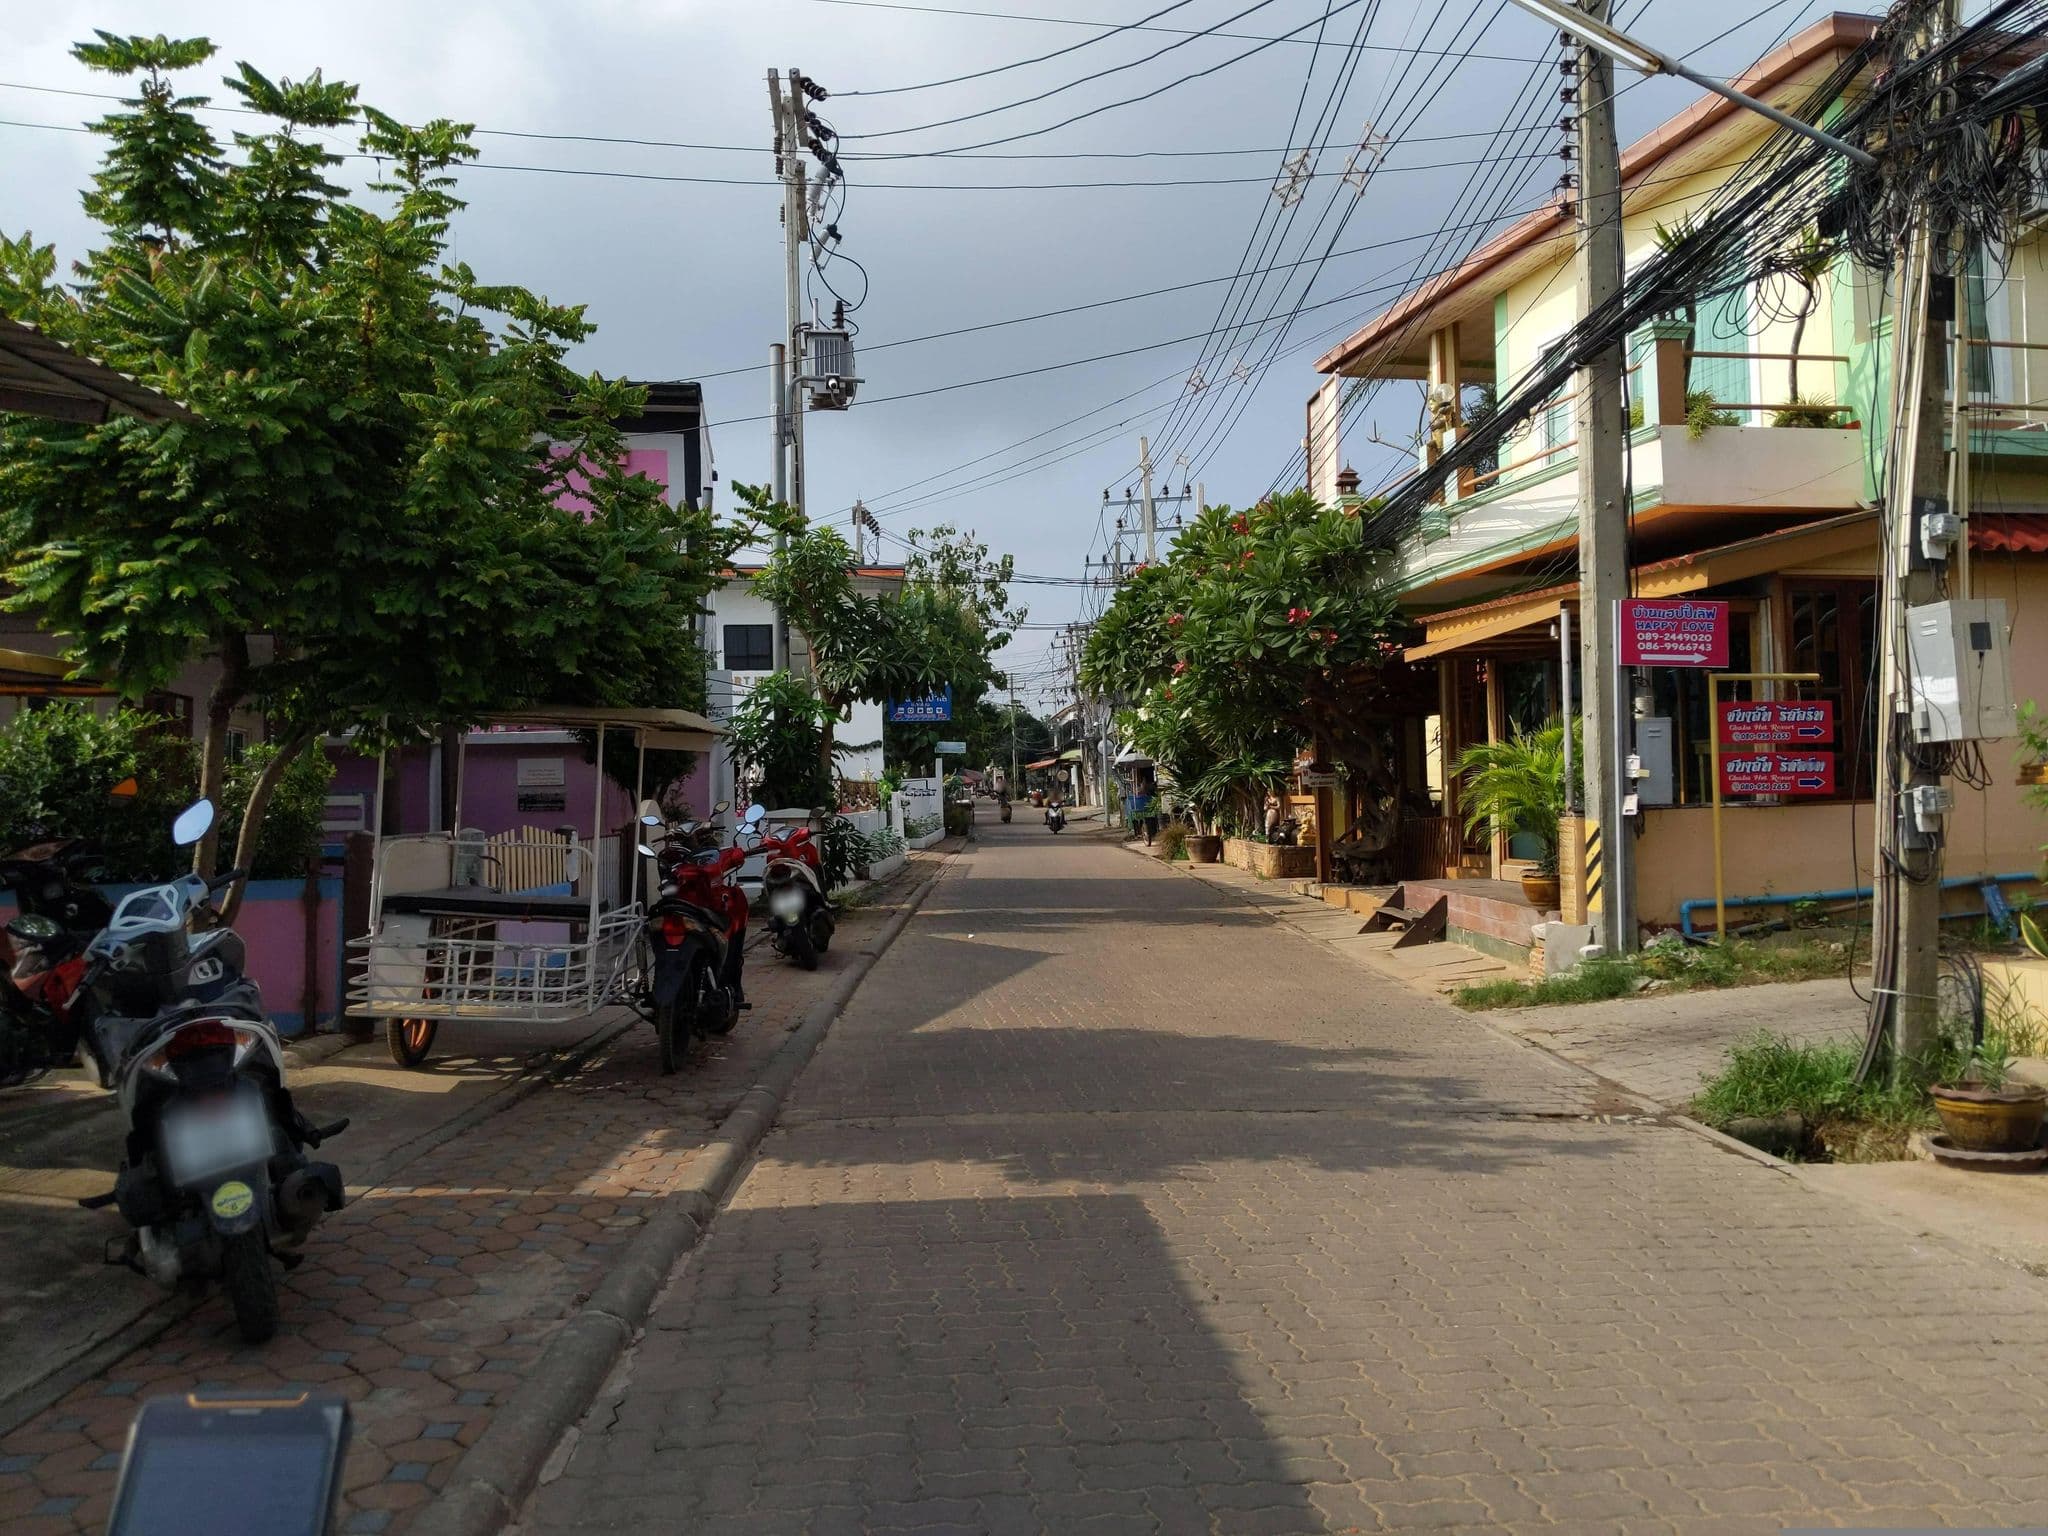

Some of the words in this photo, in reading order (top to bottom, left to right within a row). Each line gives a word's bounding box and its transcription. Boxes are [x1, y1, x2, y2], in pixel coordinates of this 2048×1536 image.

[1632, 603, 1717, 620] บ้านแฮปปี้เลิฟ
[1635, 621, 1678, 631] HAPPY
[1682, 621, 1714, 632] LOVE
[1637, 632, 1713, 642] 089-2449020
[1637, 642, 1713, 652] 086-9966743
